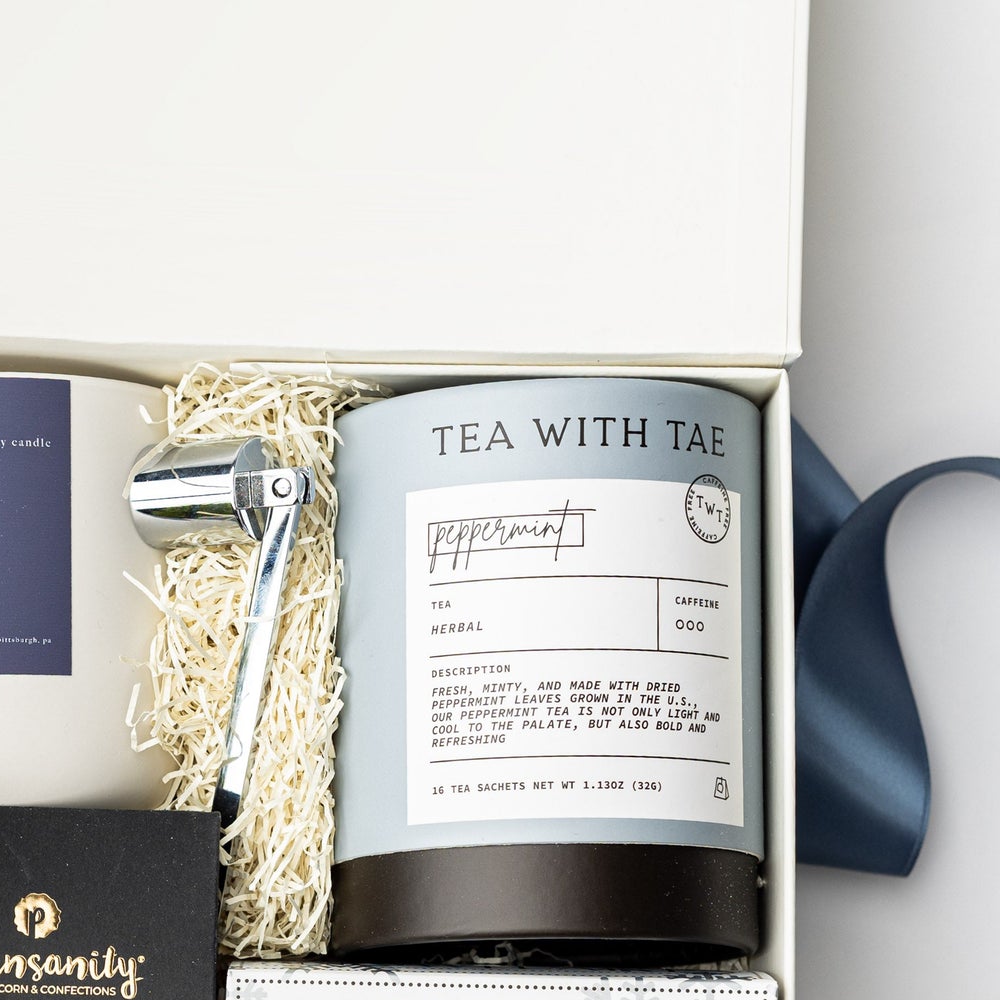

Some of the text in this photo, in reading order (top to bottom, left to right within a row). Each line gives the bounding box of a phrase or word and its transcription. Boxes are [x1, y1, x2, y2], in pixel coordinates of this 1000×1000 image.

[12, 438, 50, 447] candle
[432, 417, 724, 457] TEA WITH TAE
[429, 499, 596, 573] peppermint
[432, 601, 451, 609] TEA
[676, 597, 719, 609] CAFFEINE
[432, 621, 482, 635] HERBAL
[432, 665, 510, 678] DESCRIPTION
[432, 681, 680, 699] FRESH, MINTY, AND MADE WITH DRIED
[432, 692, 697, 711] PEPPERMINT LEAVES GROWN IN THE U.S.,
[432, 705, 720, 722] OUR PEPPERMINT TEA IS NOT ONLY LIGHT AND
[432, 720, 706, 735] COOL TO THE PALATE, BUT ALSO BOLD AND
[432, 732, 505, 747] REFRESHING
[433, 786, 444, 795] 16
[451, 785, 470, 793] TEA
[478, 782, 525, 791] SACHETS
[534, 781, 554, 789] NET
[562, 781, 575, 789] WT
[633, 781, 661, 792] (32G)
[31, 985, 38, 994] &
[40, 985, 116, 996] CONFECTIONS
